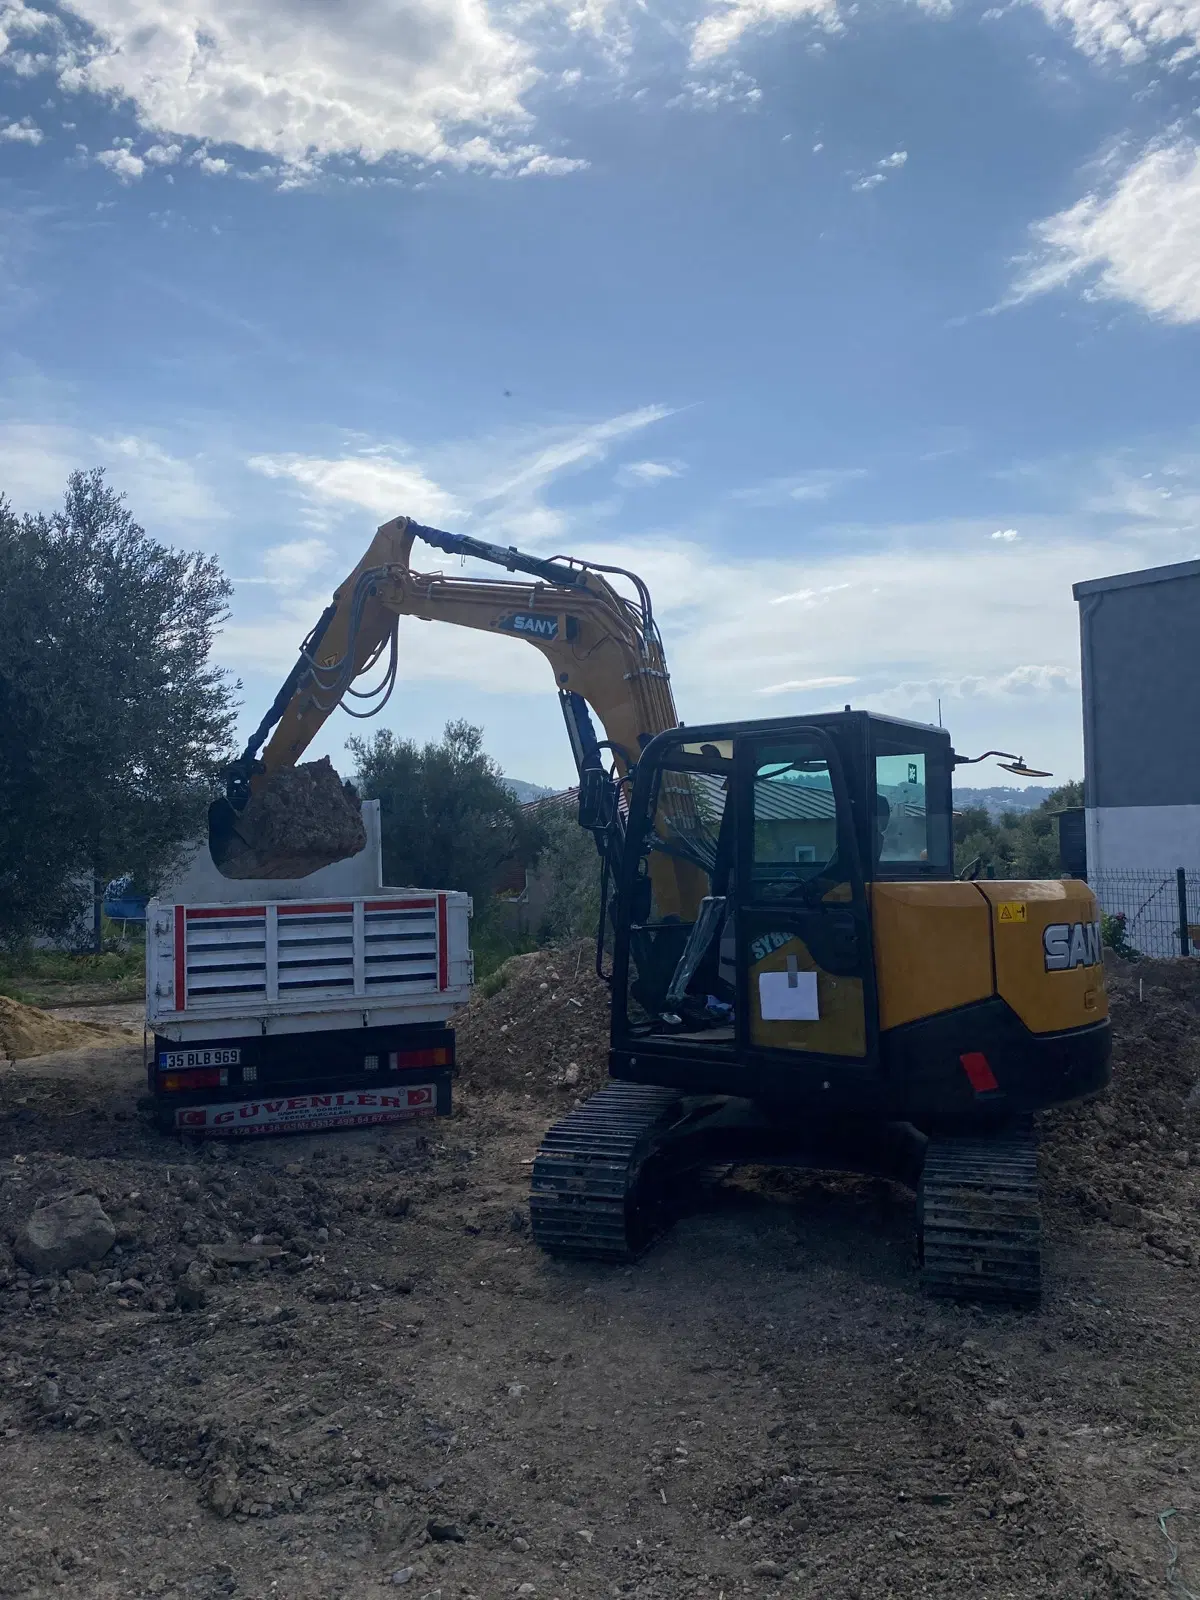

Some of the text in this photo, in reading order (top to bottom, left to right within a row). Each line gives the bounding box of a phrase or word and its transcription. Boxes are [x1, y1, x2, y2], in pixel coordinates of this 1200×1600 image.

[514, 616, 558, 634] SANY
[168, 1054, 184, 1067] 35
[187, 1052, 211, 1066] BLB
[214, 1050, 238, 1064] 969
[213, 1094, 402, 1125] GÜVENLER
